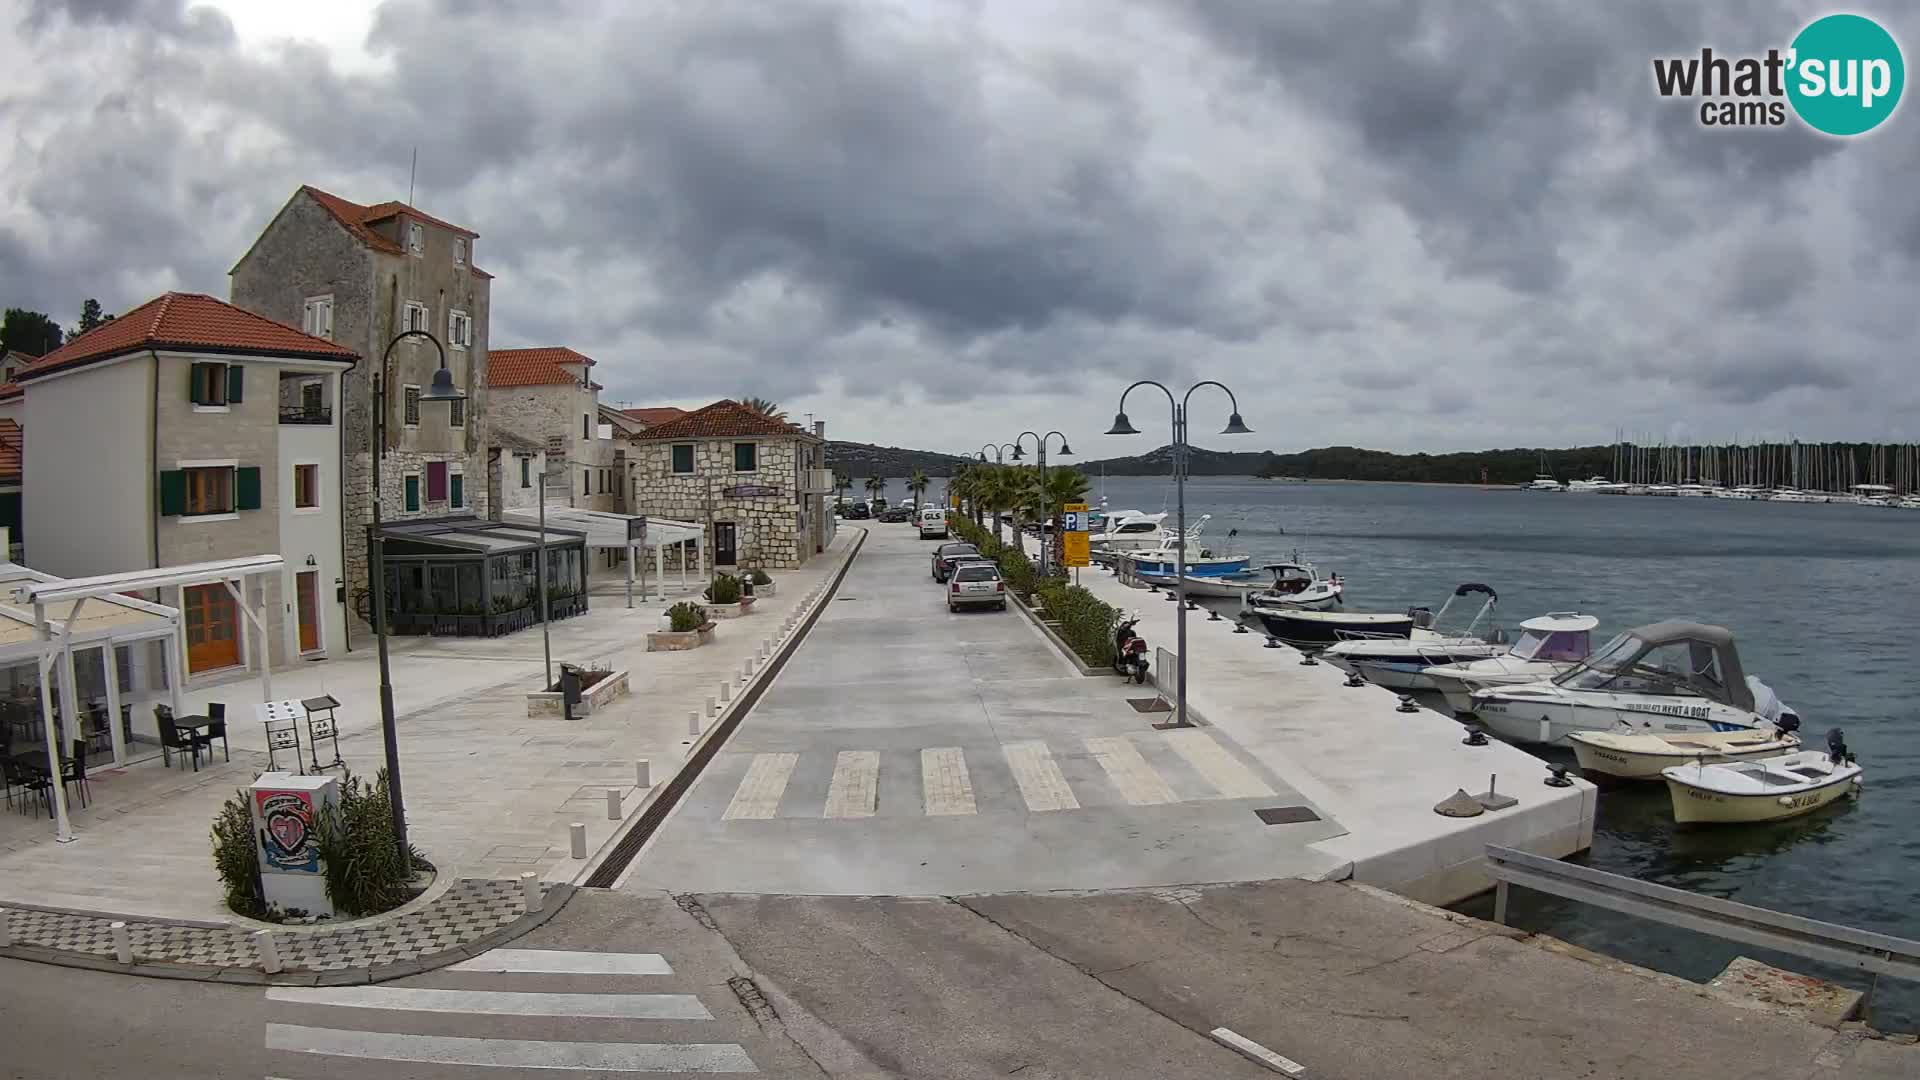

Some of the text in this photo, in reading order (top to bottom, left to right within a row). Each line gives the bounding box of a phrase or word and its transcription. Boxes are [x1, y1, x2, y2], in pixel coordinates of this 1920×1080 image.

[924, 512, 941, 520] GLS
[1662, 704, 1684, 714] RENT
[1684, 705, 1689, 715] A
[1690, 706, 1711, 719] BOAT
